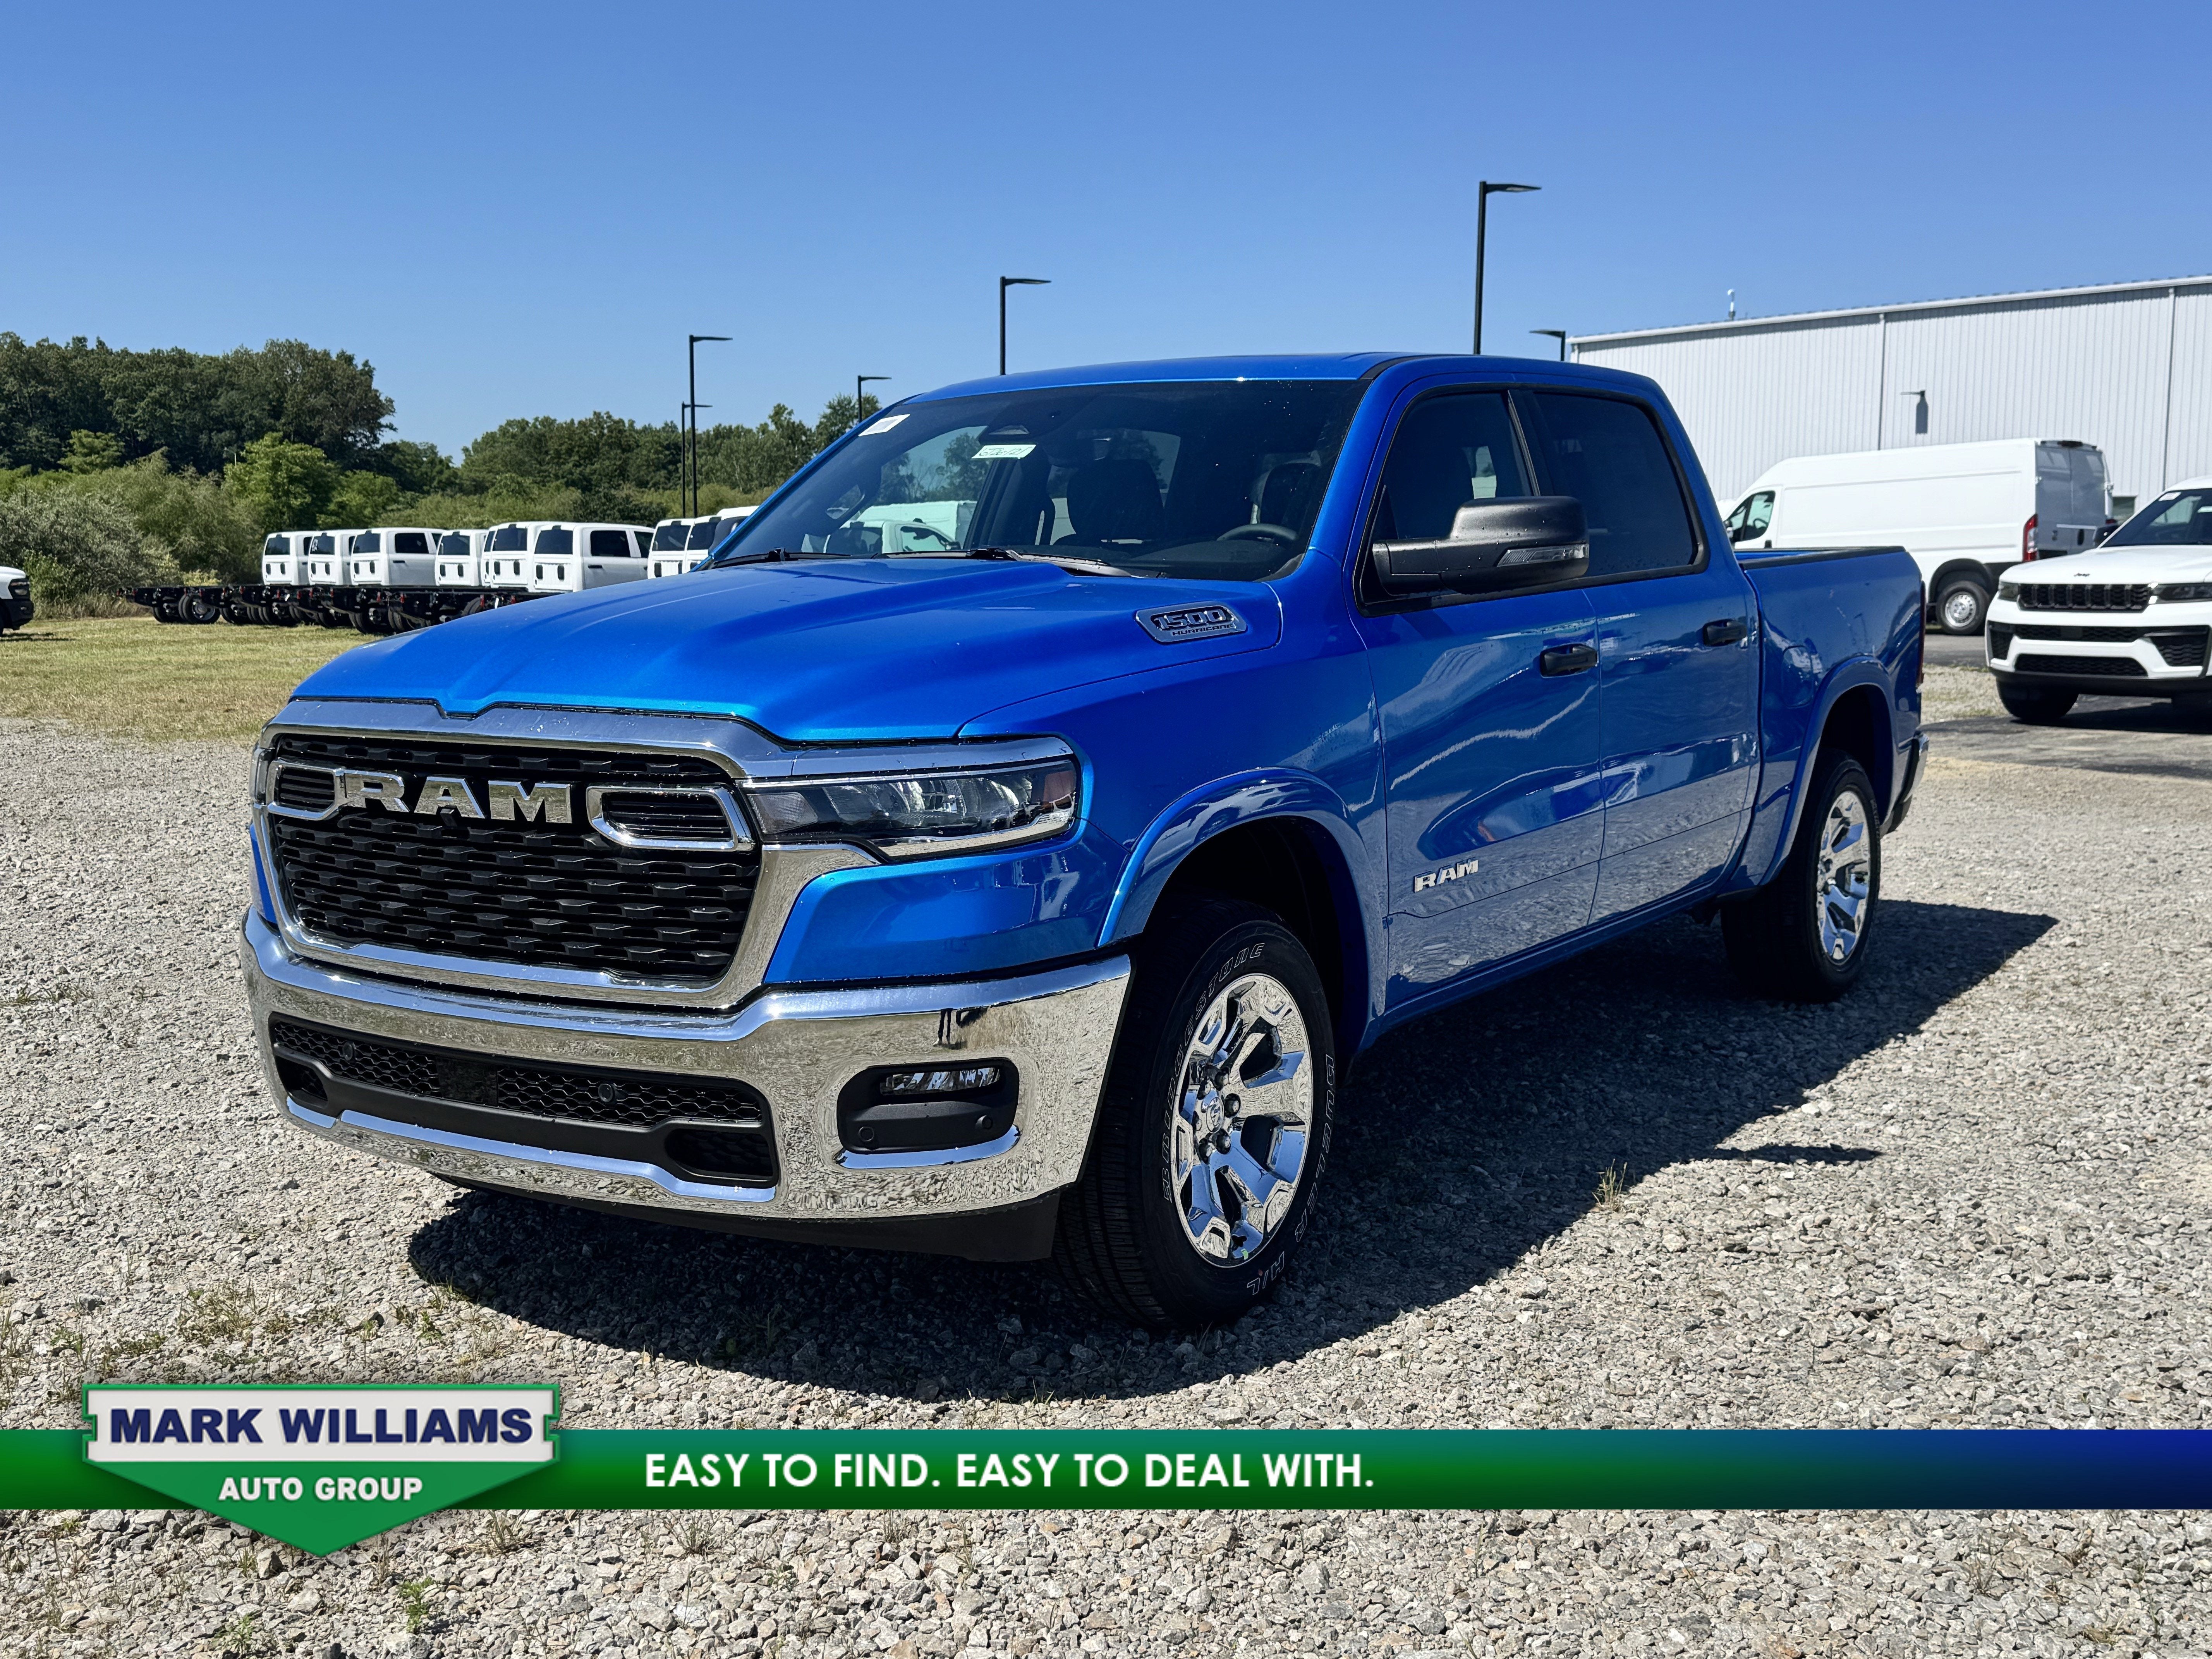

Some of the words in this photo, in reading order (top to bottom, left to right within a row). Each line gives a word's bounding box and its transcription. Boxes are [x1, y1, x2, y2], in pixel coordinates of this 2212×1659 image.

[1154, 609, 1226, 630] 1500
[1172, 623, 1234, 636] HURRICANE
[344, 769, 573, 824] RAM
[1413, 857, 1479, 893] RAM
[1161, 943, 1266, 1204] BRIDGESTONE
[1294, 1054, 1336, 1243] DUELER
[1247, 1250, 1285, 1296] H/L
